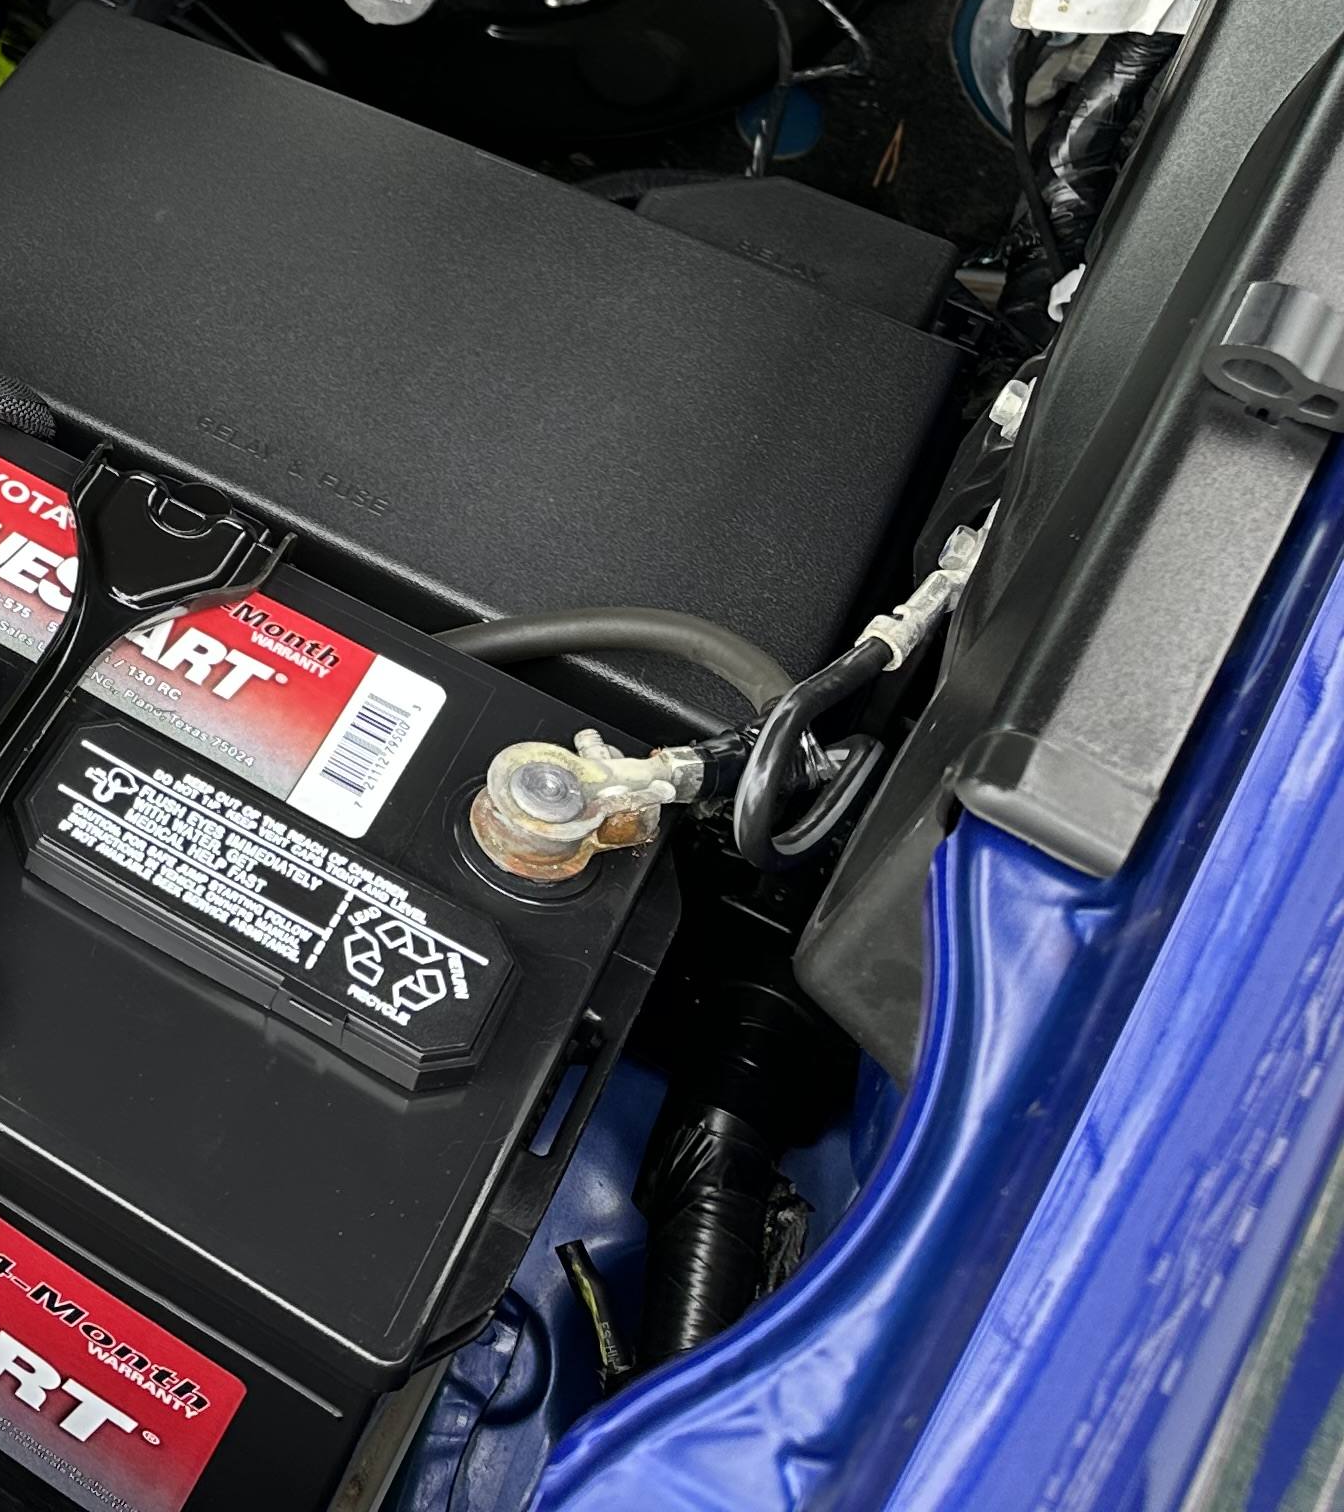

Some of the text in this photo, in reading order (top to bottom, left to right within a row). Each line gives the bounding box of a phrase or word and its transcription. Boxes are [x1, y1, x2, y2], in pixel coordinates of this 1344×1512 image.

[318, 471, 392, 518] FUSE
[220, 598, 342, 668] -Month
[251, 630, 330, 679] WARRANTY
[127, 664, 155, 687] 130
[168, 712, 209, 742] Texas
[210, 734, 256, 769] 75024
[132, 796, 171, 826] WITH
[226, 848, 259, 872] GET
[215, 791, 243, 811] OUT
[241, 805, 261, 820] OF
[123, 808, 268, 893] MEDICAL HELP FAST
[138, 784, 323, 891] FLUSH EYES IMMEDIATELY
[152, 769, 173, 786] DO
[172, 780, 198, 802] NOT
[225, 809, 258, 830] KEEP
[361, 882, 390, 903] AND
[347, 906, 382, 926] LEAD
[346, 983, 411, 1027] RECYCLE
[87, 1339, 201, 1420] WARRANTY
